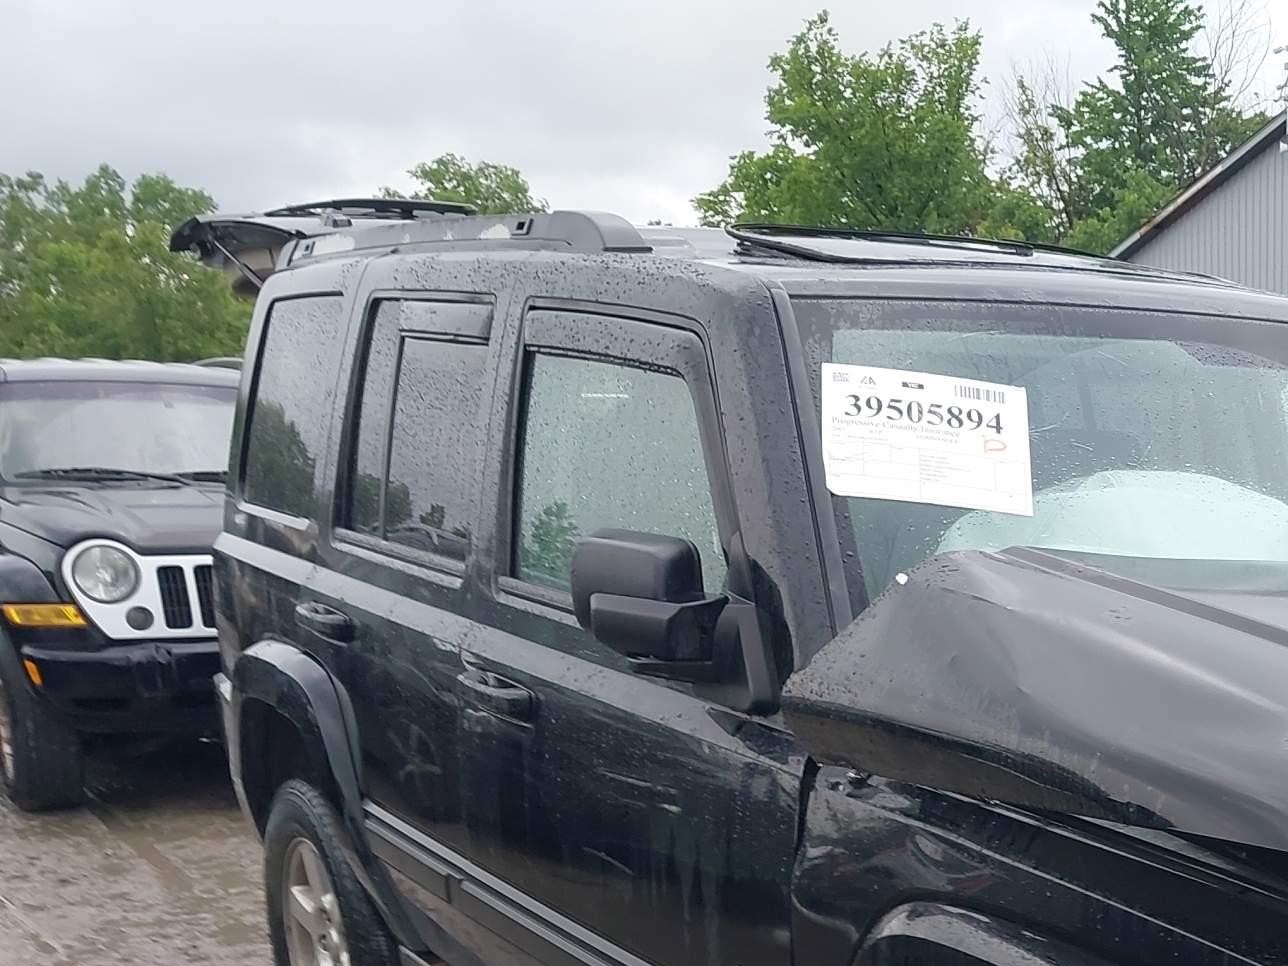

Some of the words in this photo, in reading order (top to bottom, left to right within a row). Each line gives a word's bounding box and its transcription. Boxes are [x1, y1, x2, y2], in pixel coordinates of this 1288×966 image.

[831, 416, 880, 428] Progressive
[882, 420, 917, 432] Casualty
[920, 426, 961, 438] Insurance
[844, 393, 1004, 435] 39505894
